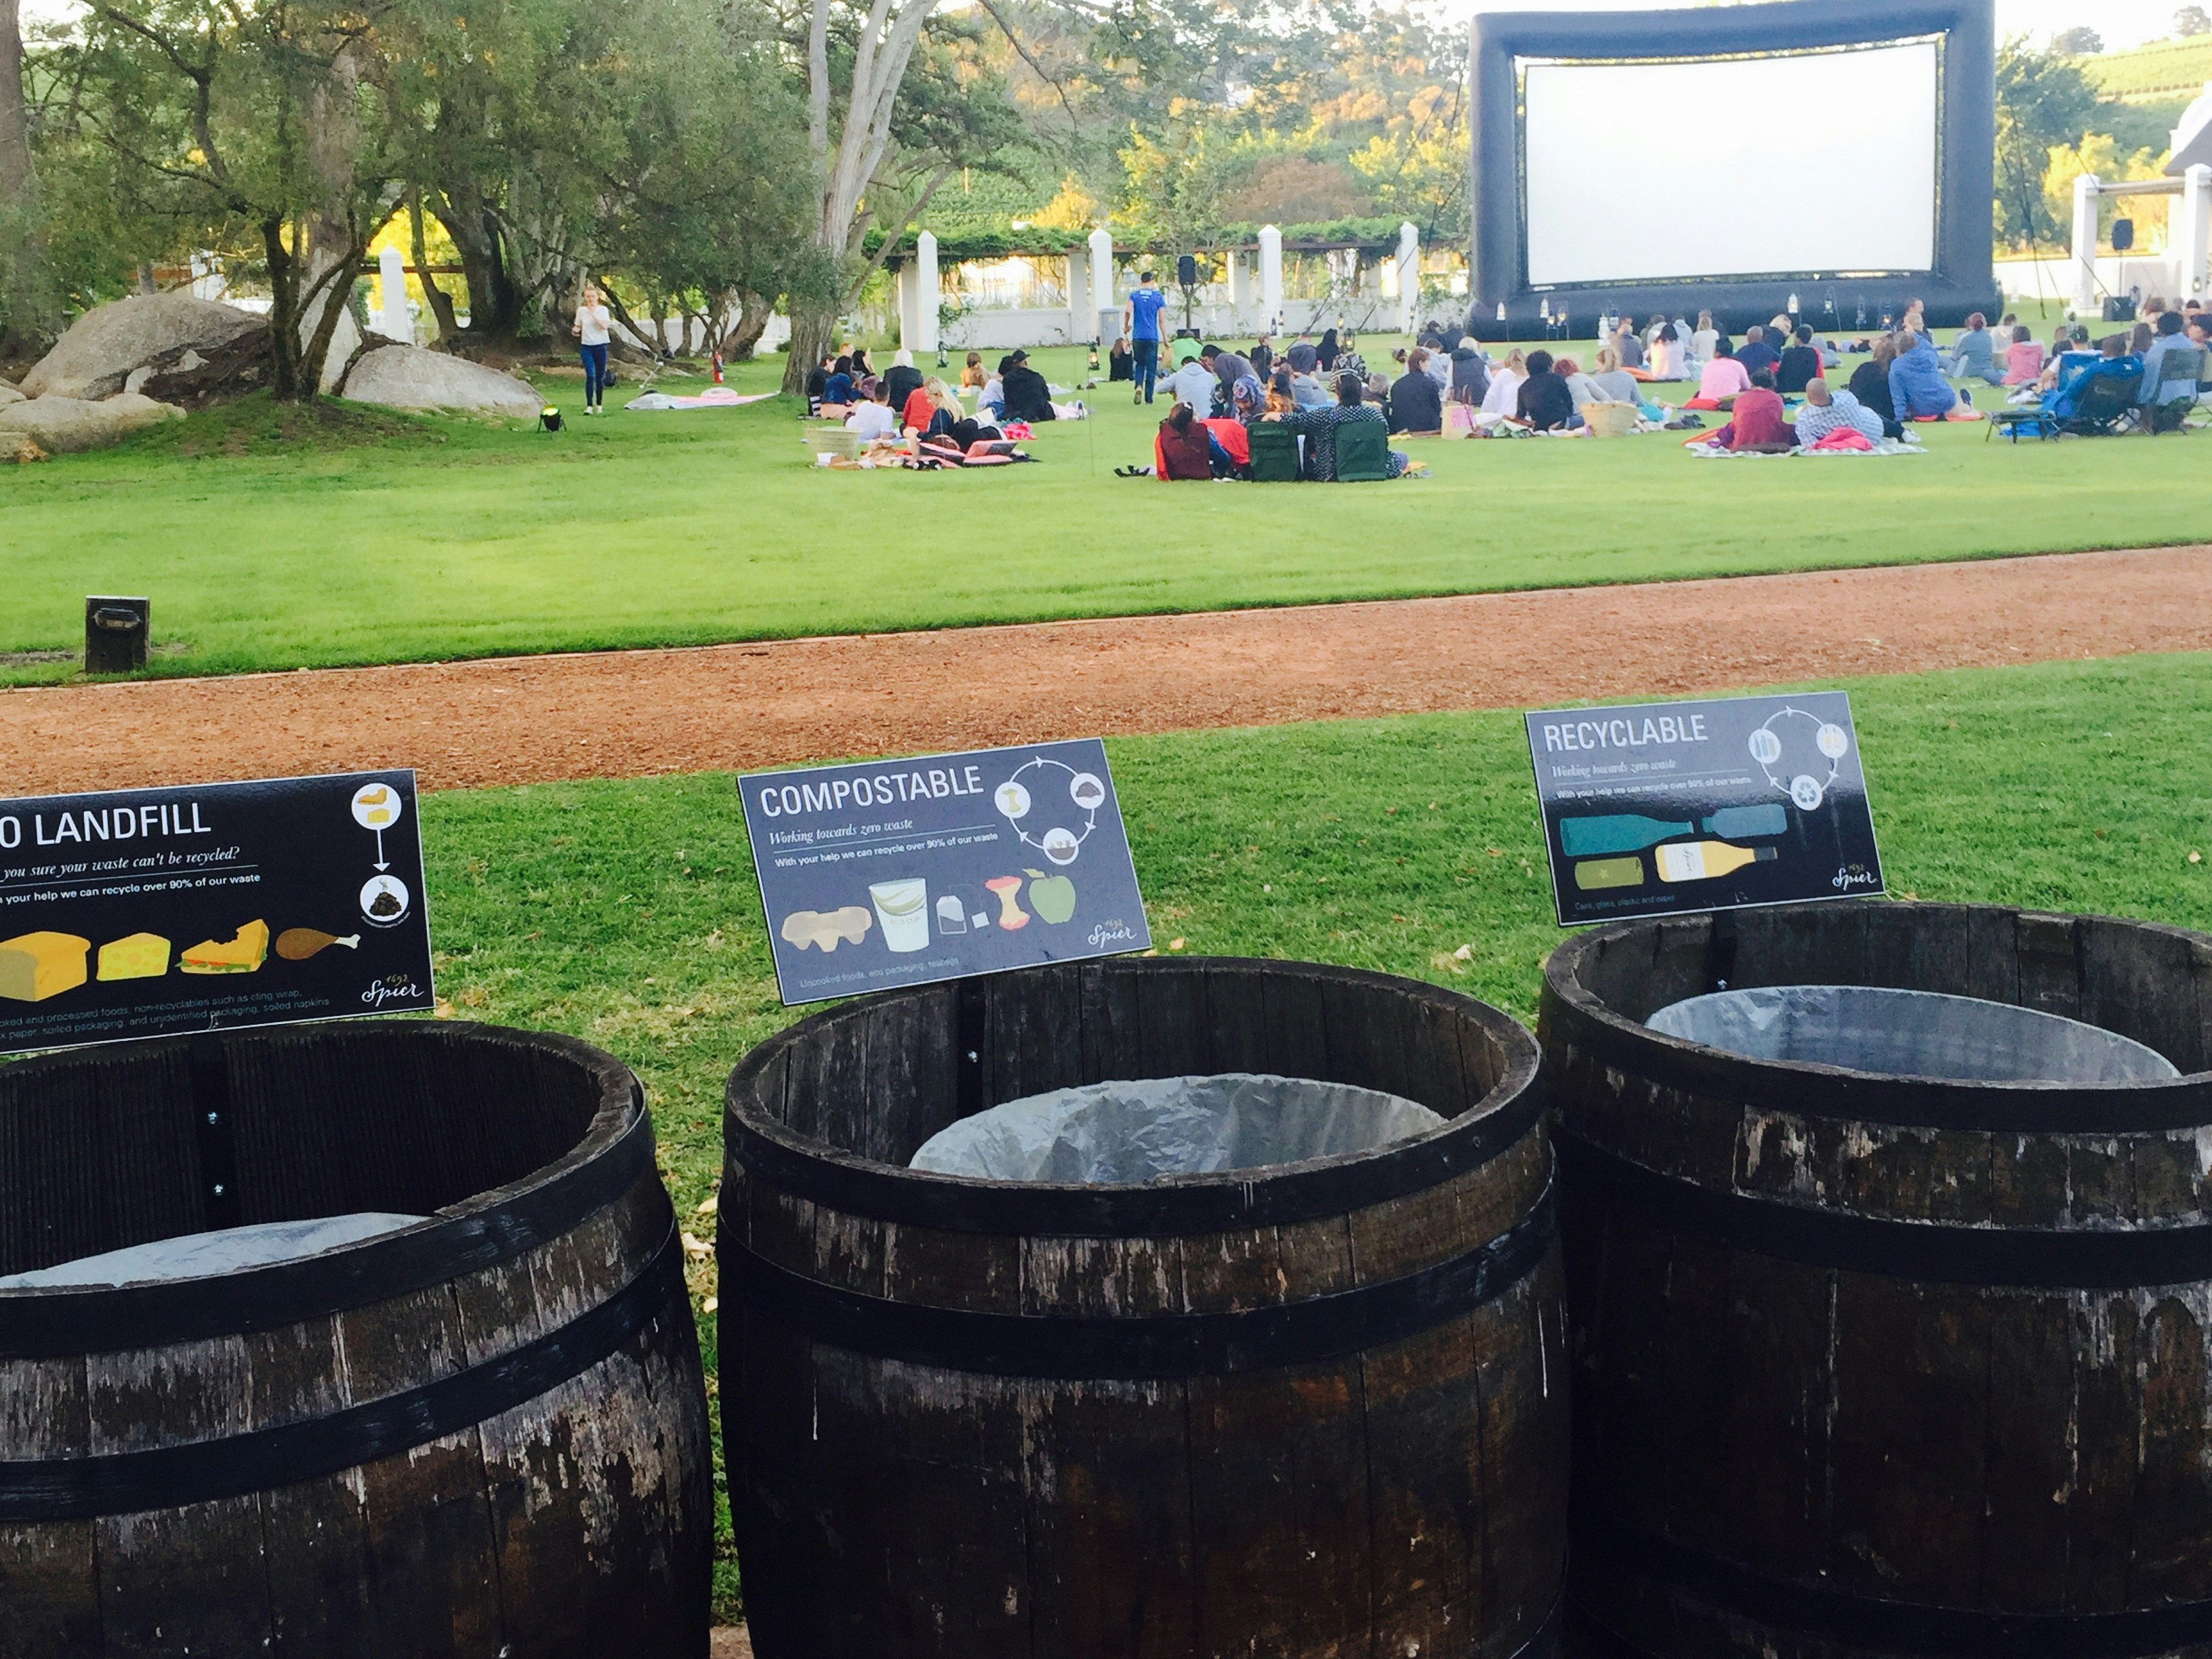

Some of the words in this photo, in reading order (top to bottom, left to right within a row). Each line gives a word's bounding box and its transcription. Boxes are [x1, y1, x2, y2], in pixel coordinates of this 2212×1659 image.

[1543, 714, 1708, 752] RECYCLABLE
[1552, 764, 1591, 779] Working
[760, 766, 984, 817] COMPOSTABLE
[1556, 790, 1575, 799] With
[1576, 789, 1594, 798] your
[1595, 787, 1613, 796] help
[1626, 785, 1641, 794] can
[35, 802, 211, 845] LANDFILL
[769, 831, 814, 845] Working
[817, 824, 857, 840] towards
[861, 824, 881, 836] zero
[884, 819, 914, 831] waste
[775, 857, 797, 867] With
[798, 855, 819, 867] your
[821, 852, 840, 863] help
[842, 851, 856, 860] we
[857, 849, 872, 858] can
[874, 844, 905, 857] recycle
[906, 842, 926, 852] over
[926, 838, 946, 849] 90%
[947, 838, 957, 847] of
[958, 836, 972, 845] our
[974, 833, 999, 842] waste
[0, 867, 26, 883] you
[30, 865, 56, 876] sure
[56, 863, 88, 878] your
[92, 857, 129, 871] waste
[132, 852, 164, 867] can't
[168, 849, 182, 865] be
[186, 846, 240, 867] recycled?
[5, 894, 31, 905] your
[33, 890, 58, 901] help
[60, 890, 77, 899] we
[79, 888, 100, 897] can
[102, 884, 140, 896] recycle
[143, 882, 167, 892] over
[169, 878, 193, 889] 90%
[195, 877, 207, 886] of
[209, 877, 227, 886] our
[229, 873, 260, 884] waste
[1832, 867, 1877, 891] Spier
[1088, 924, 1138, 949] Spier
[1105, 918, 1124, 930] 1692
[361, 979, 425, 1007] Spier
[386, 973, 409, 987] 1692
[26, 1015, 44, 1025] and
[47, 1008, 98, 1024] processed
[212, 995, 234, 1005] such
[129, 1015, 148, 1025] and
[150, 1008, 207, 1023] unidentified
[263, 1000, 291, 1012] soiled
[293, 998, 330, 1009] napkins
